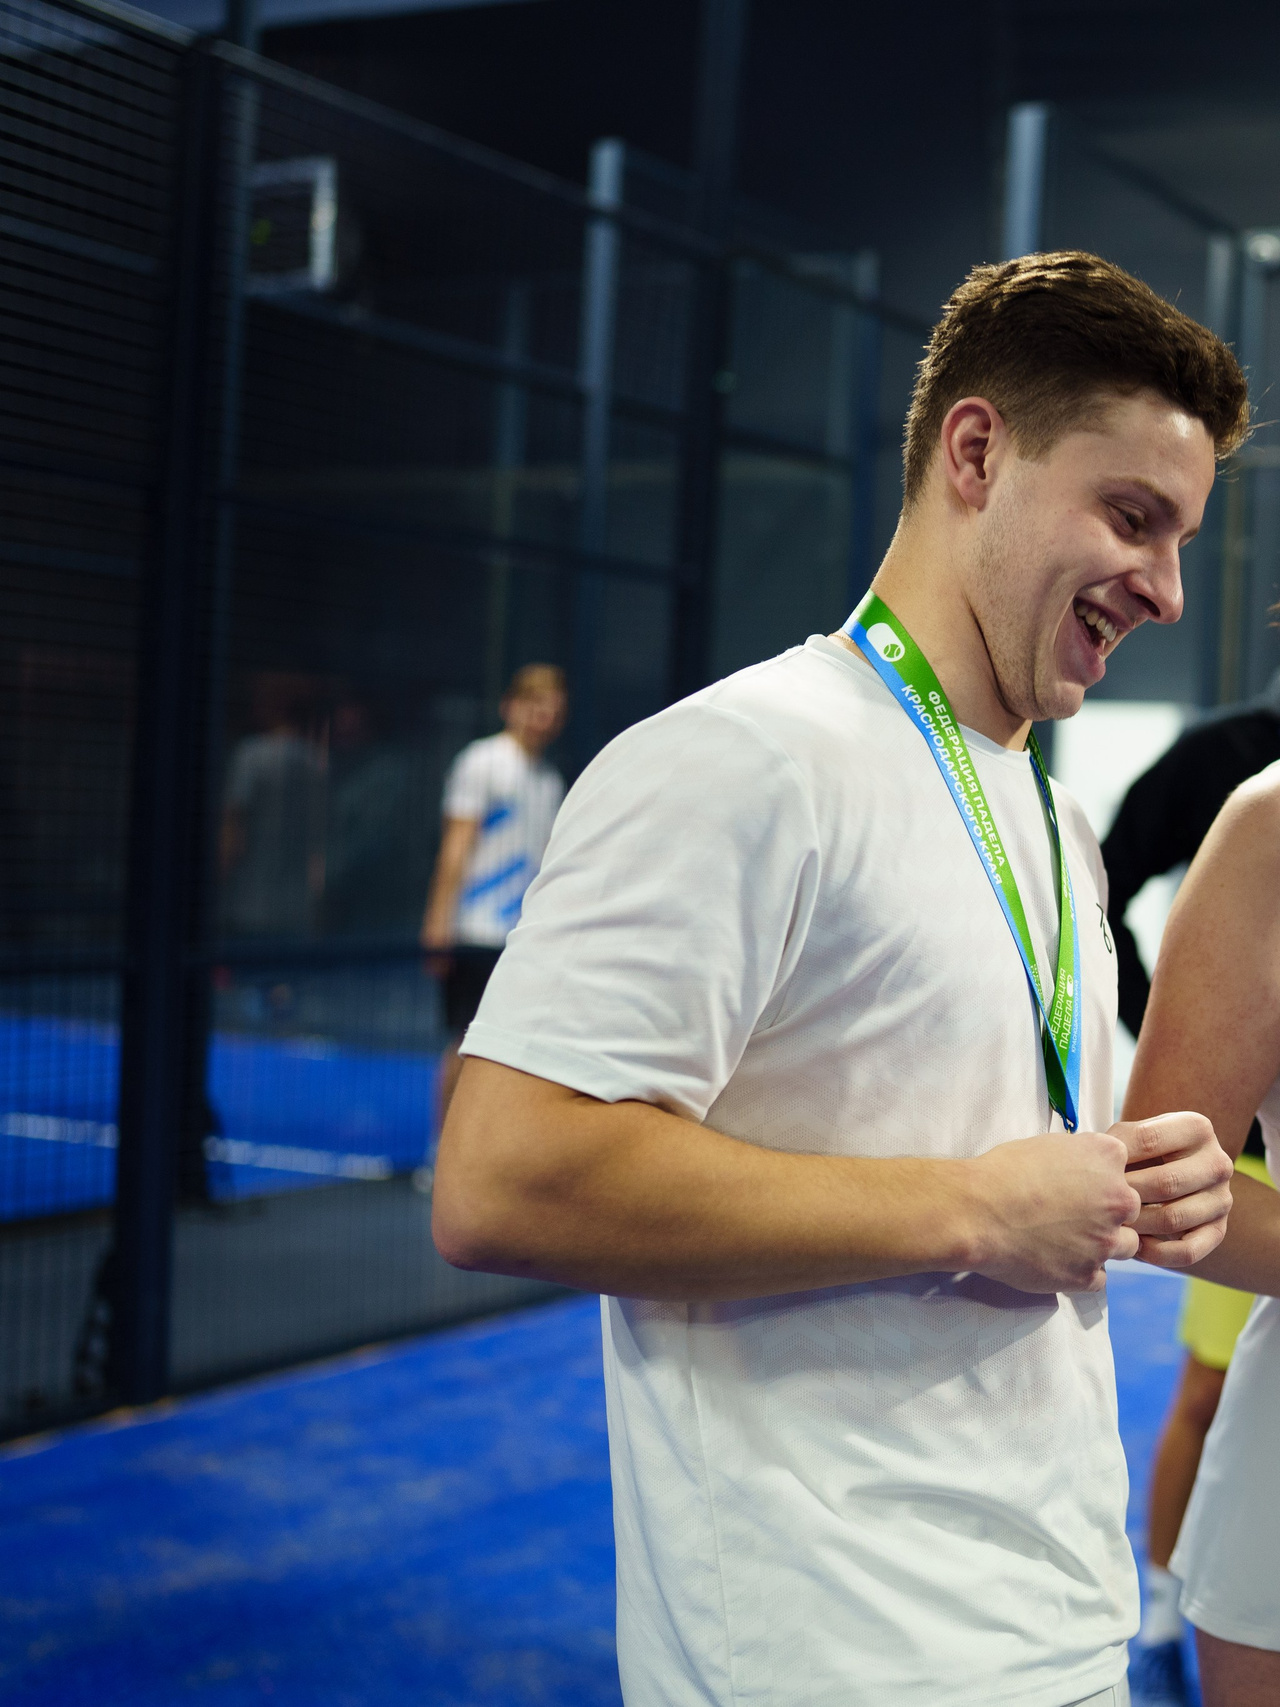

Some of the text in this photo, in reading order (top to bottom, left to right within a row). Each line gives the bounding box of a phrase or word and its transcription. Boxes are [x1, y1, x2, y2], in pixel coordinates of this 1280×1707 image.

[901, 684, 1003, 886] КРАСНОДАРСКОГО КРАЯ
[928, 690, 1005, 867] ФЕДЕРАЦИЯ ПАДЕЛА
[1059, 1000, 1073, 1050] ПАДЕЛА
